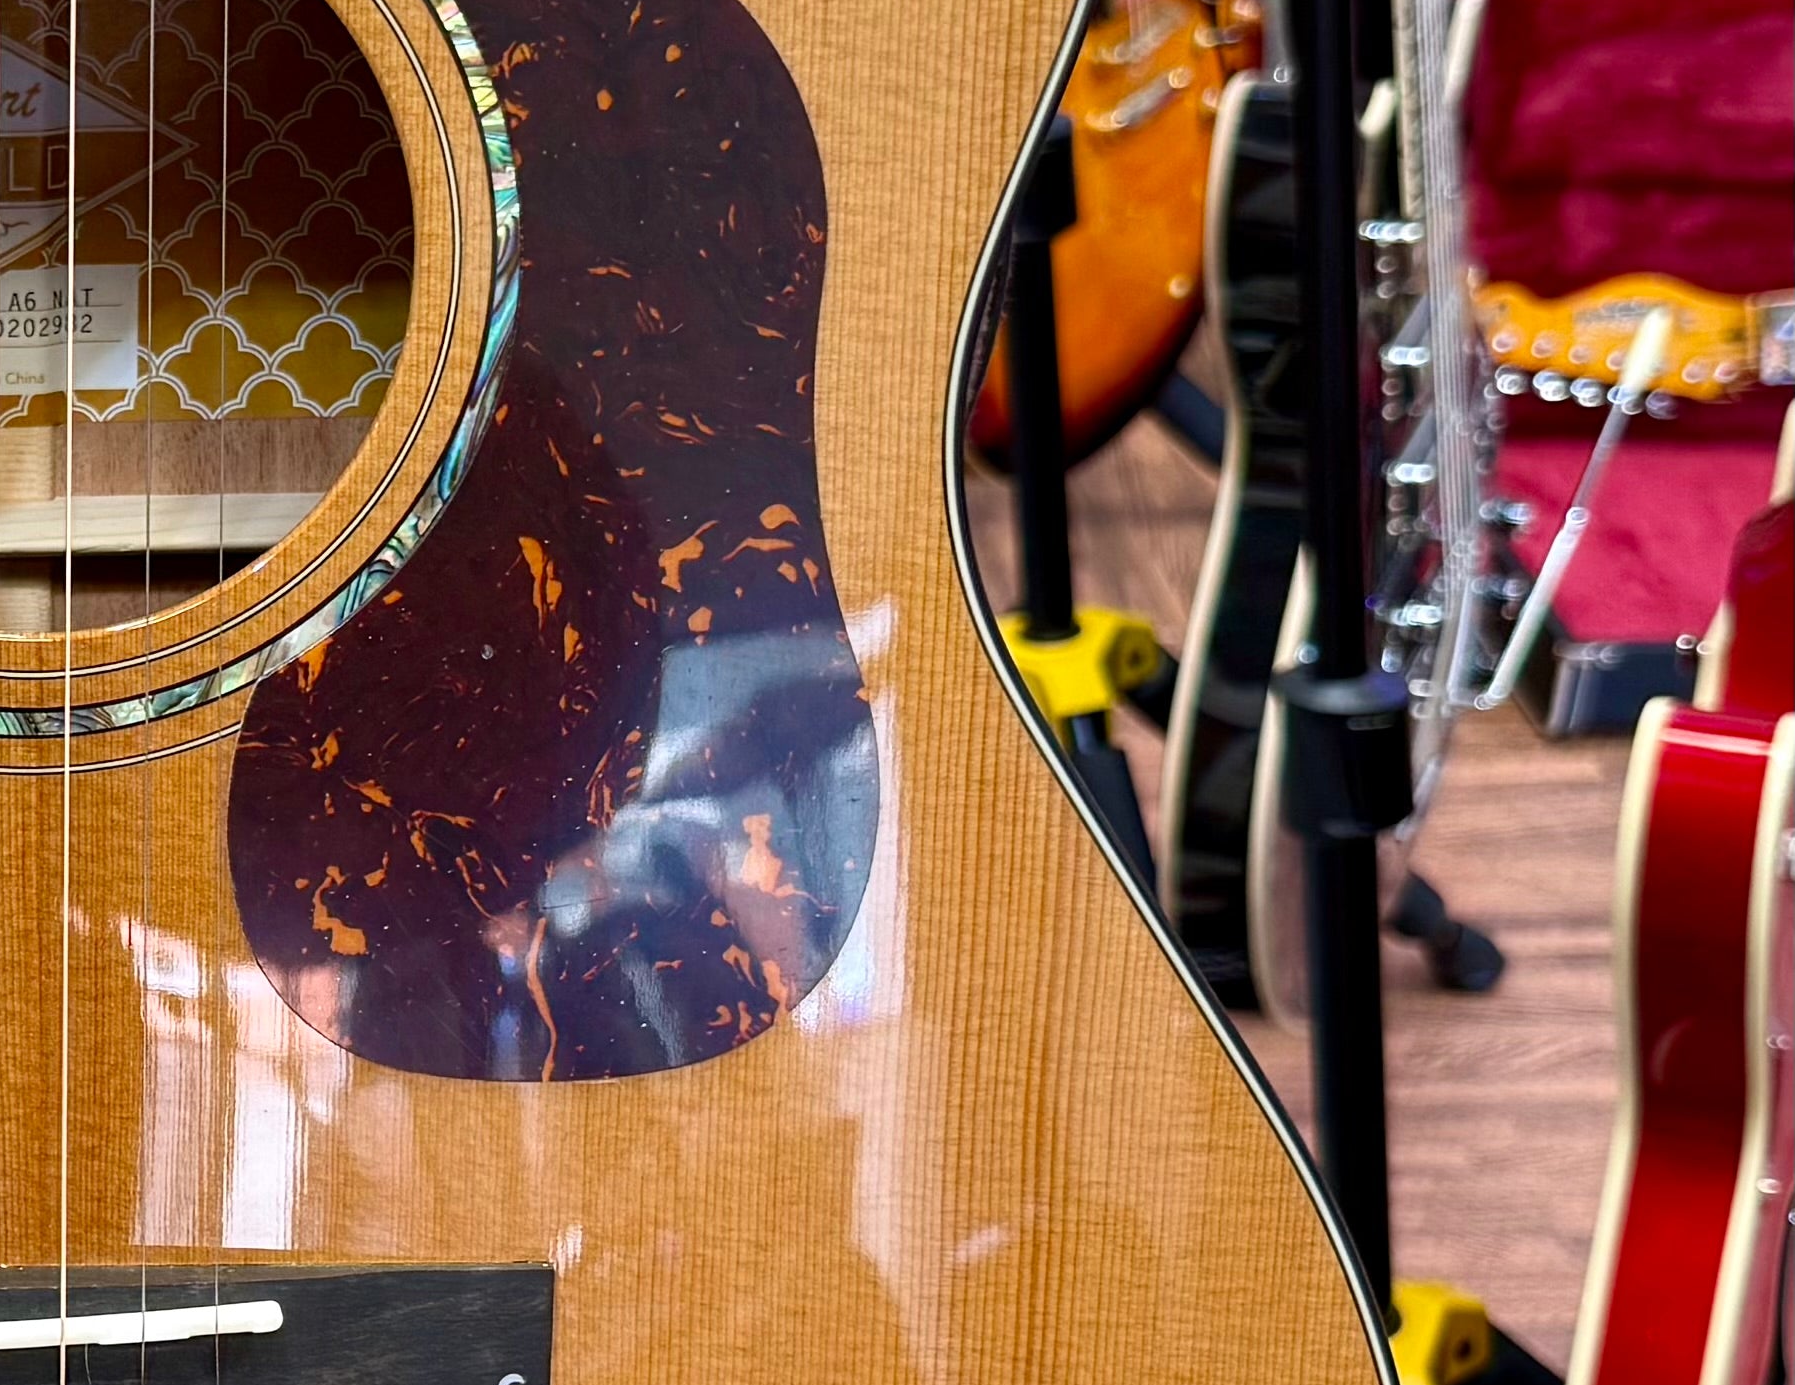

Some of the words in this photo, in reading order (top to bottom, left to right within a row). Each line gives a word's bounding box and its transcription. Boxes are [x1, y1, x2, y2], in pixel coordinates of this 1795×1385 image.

[8, 291, 36, 312] A6
[52, 287, 93, 310] NT
[5, 372, 45, 384] China
